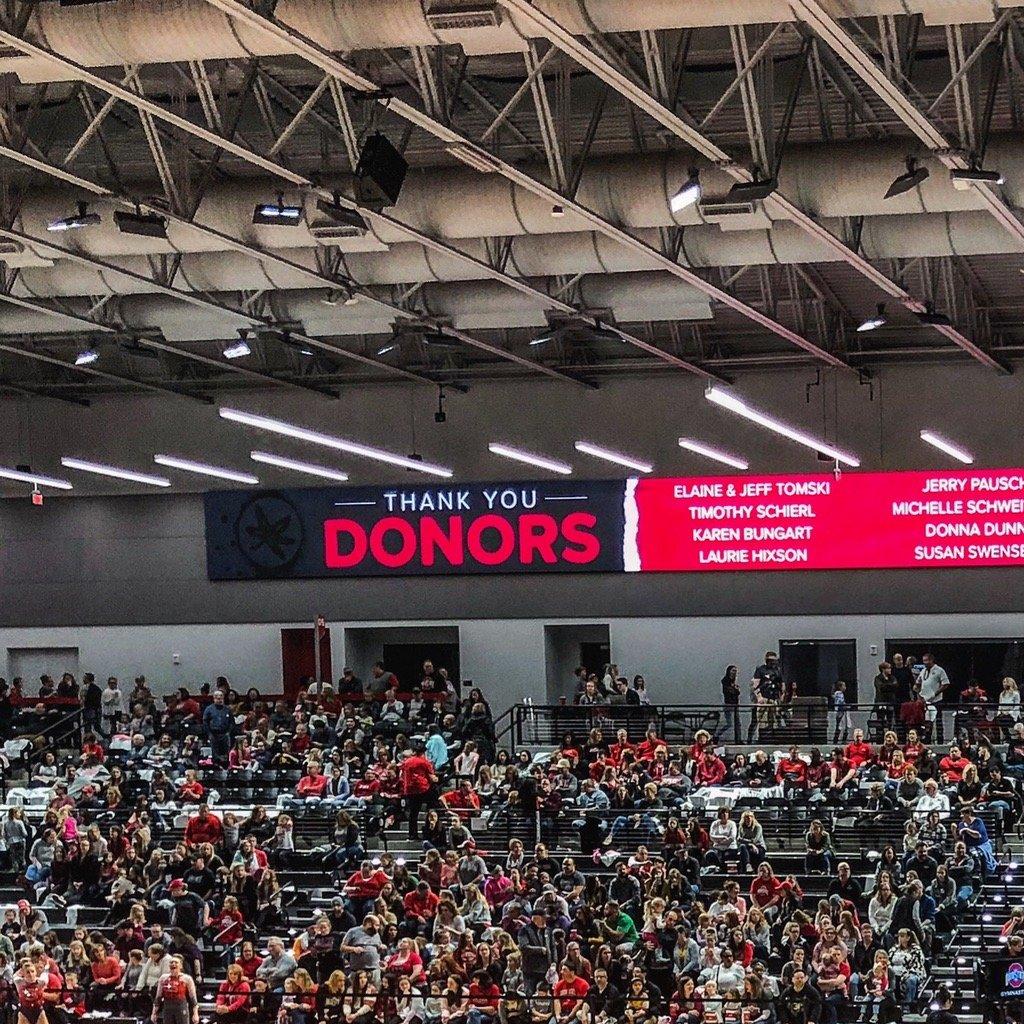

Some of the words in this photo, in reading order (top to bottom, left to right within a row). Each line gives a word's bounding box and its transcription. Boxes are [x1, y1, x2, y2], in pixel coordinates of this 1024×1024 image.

[673, 484, 724, 498] ELAINE
[725, 484, 737, 497] &
[739, 483, 773, 496] JEFF
[775, 482, 831, 496] TOMSKI
[921, 478, 968, 492] JERRY
[383, 491, 471, 512] THANK
[483, 489, 538, 510] YOU
[688, 506, 754, 519] TIMOTHY
[755, 504, 816, 518] SCHIERL
[892, 501, 963, 515] MICHELLE
[692, 528, 741, 541] KAREN
[743, 526, 813, 540] BUNGART
[925, 523, 981, 537] DONNA
[323, 511, 601, 569] DONORS
[699, 550, 749, 563] LAURIE
[751, 549, 808, 562] HIXSON
[914, 546, 965, 559] SUSAN
